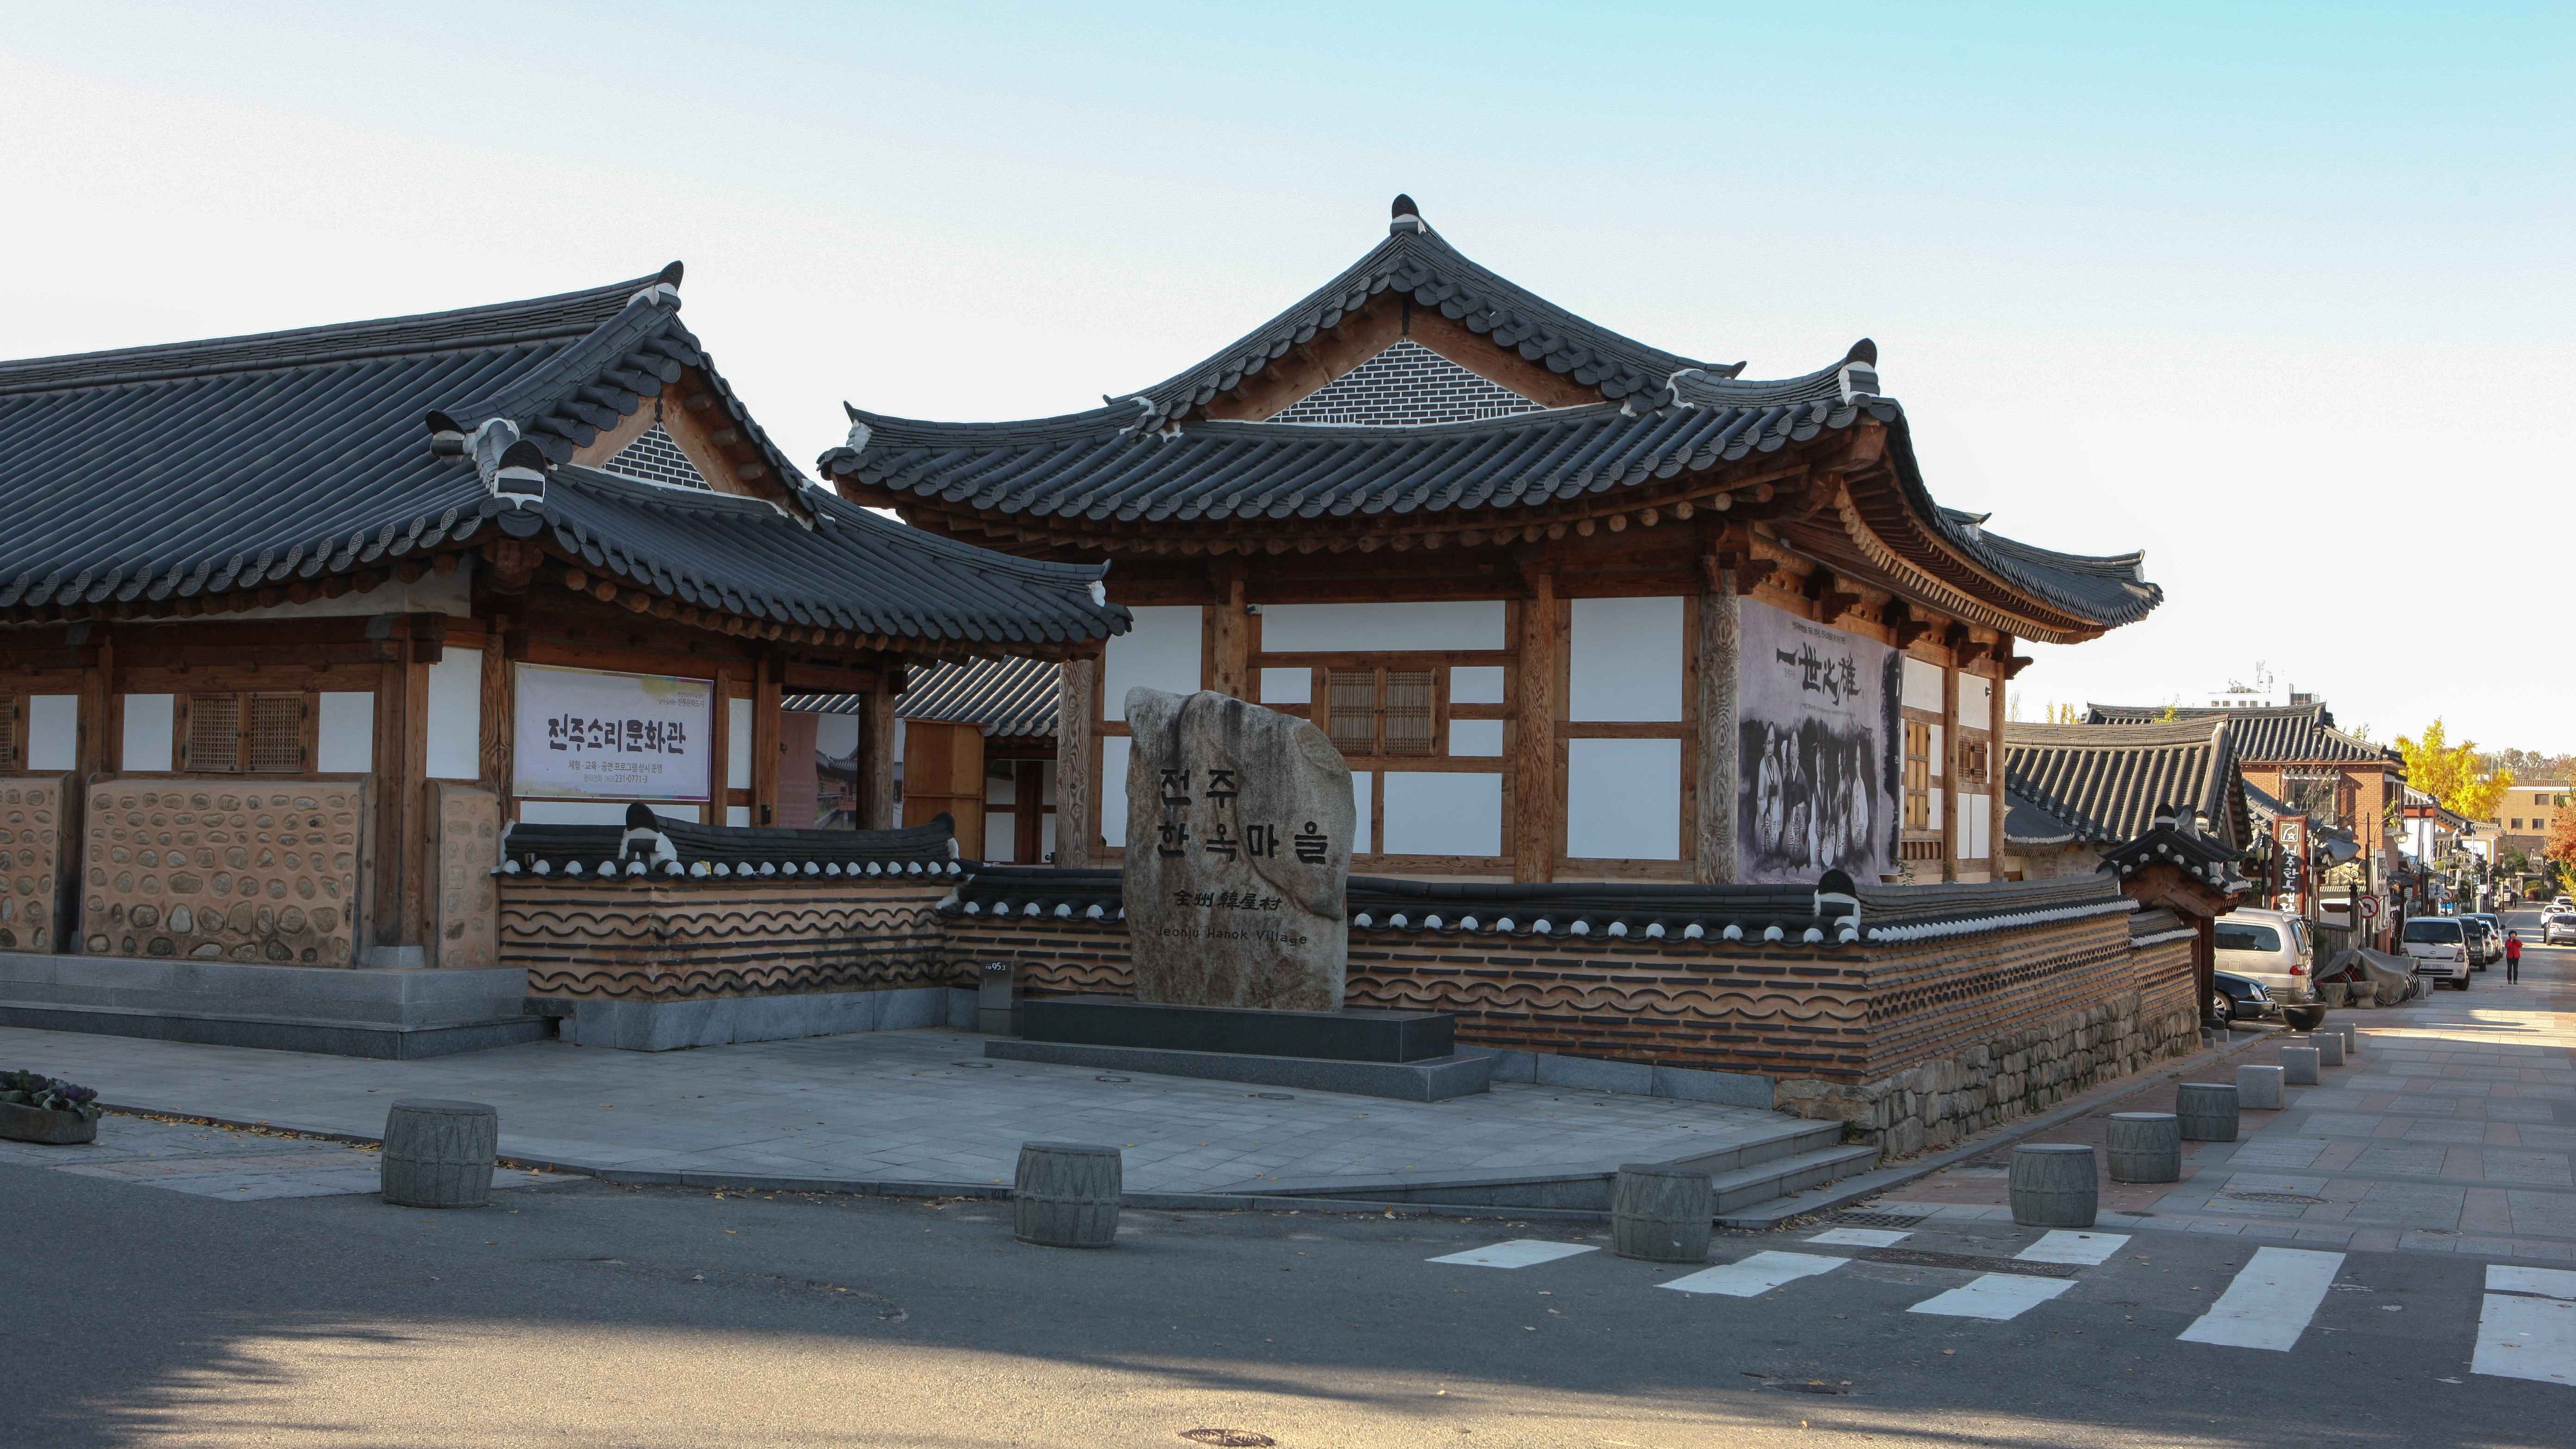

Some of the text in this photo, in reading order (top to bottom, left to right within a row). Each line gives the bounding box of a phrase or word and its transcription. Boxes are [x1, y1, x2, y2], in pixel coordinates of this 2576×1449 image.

[677, 698, 704, 708] 전통문화도시
[548, 713, 687, 755] 전주소리문화관
[569, 760, 663, 773] 체험 교육 공연 프로그램 상시 운영
[1161, 769, 1238, 808] 전주
[1157, 821, 1328, 864] 한옥마을
[1156, 927, 1307, 946] Jeonju Hanok Village
